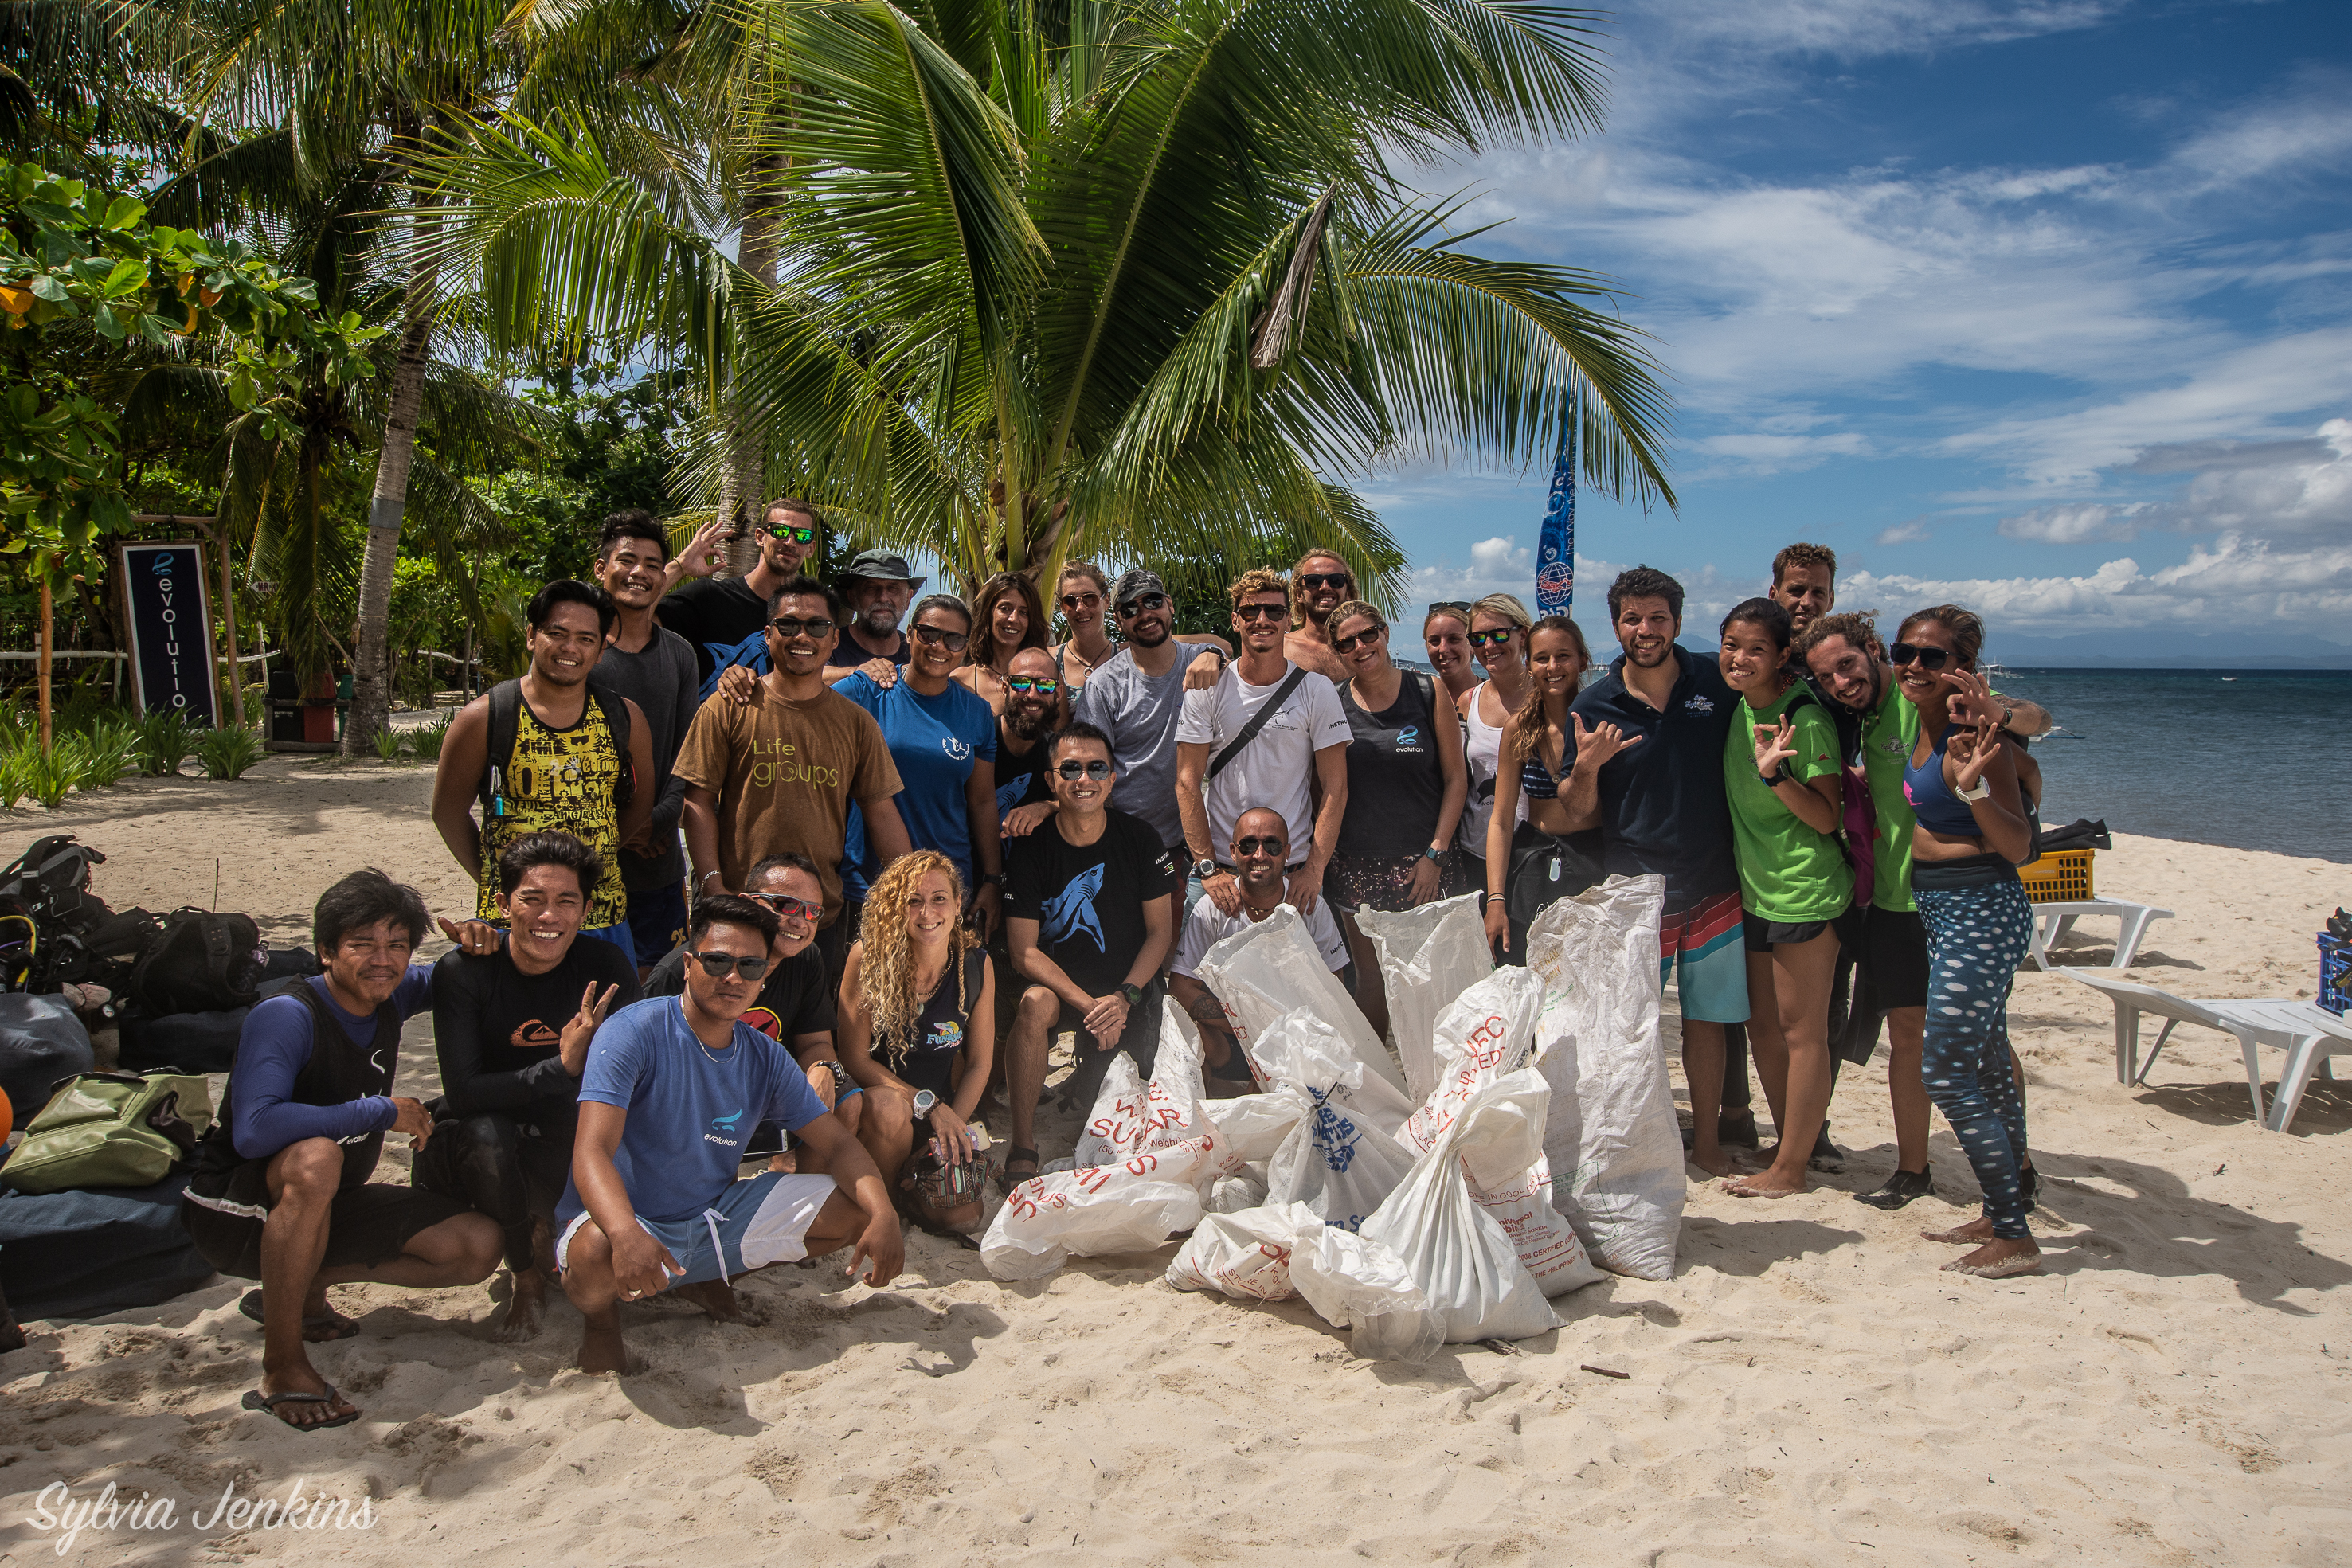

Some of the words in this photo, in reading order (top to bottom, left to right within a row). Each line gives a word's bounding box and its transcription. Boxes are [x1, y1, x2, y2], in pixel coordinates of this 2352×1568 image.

[1566, 507, 1575, 535] Way
[1566, 538, 1575, 557] The
[159, 577, 188, 725] evolutio
[753, 738, 796, 756] Life
[753, 761, 839, 789] groups
[704, 1133, 738, 1147] evolution
[1500, 1187, 1525, 1199] COOL
[1533, 1241, 1564, 1257] CERTIFIED
[1548, 1255, 1575, 1274] PHILIPPINES
[1258, 1284, 1267, 1295] IN
